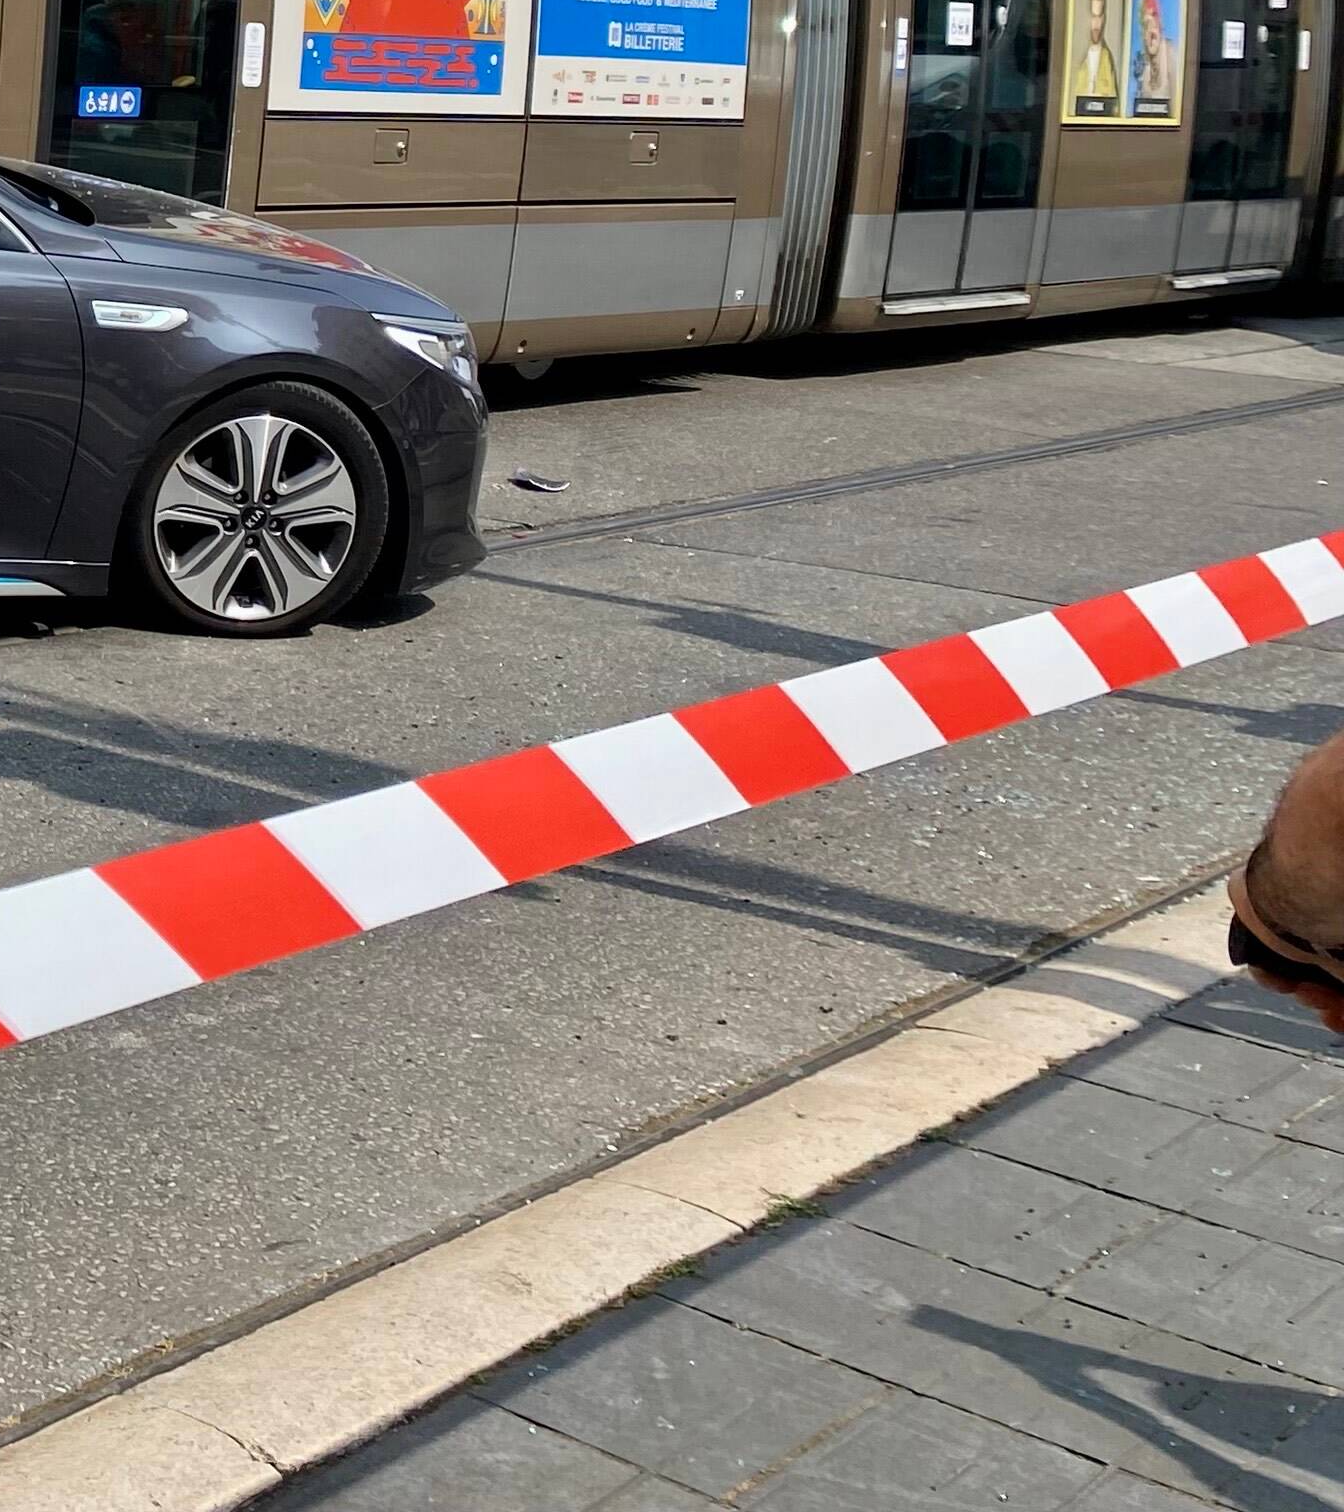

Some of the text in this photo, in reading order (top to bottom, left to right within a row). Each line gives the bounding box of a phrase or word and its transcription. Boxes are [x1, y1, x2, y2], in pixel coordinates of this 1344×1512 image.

[625, 22, 635, 32] LA
[624, 34, 684, 51] BILLETTERIE
[245, 510, 264, 528] KIA
